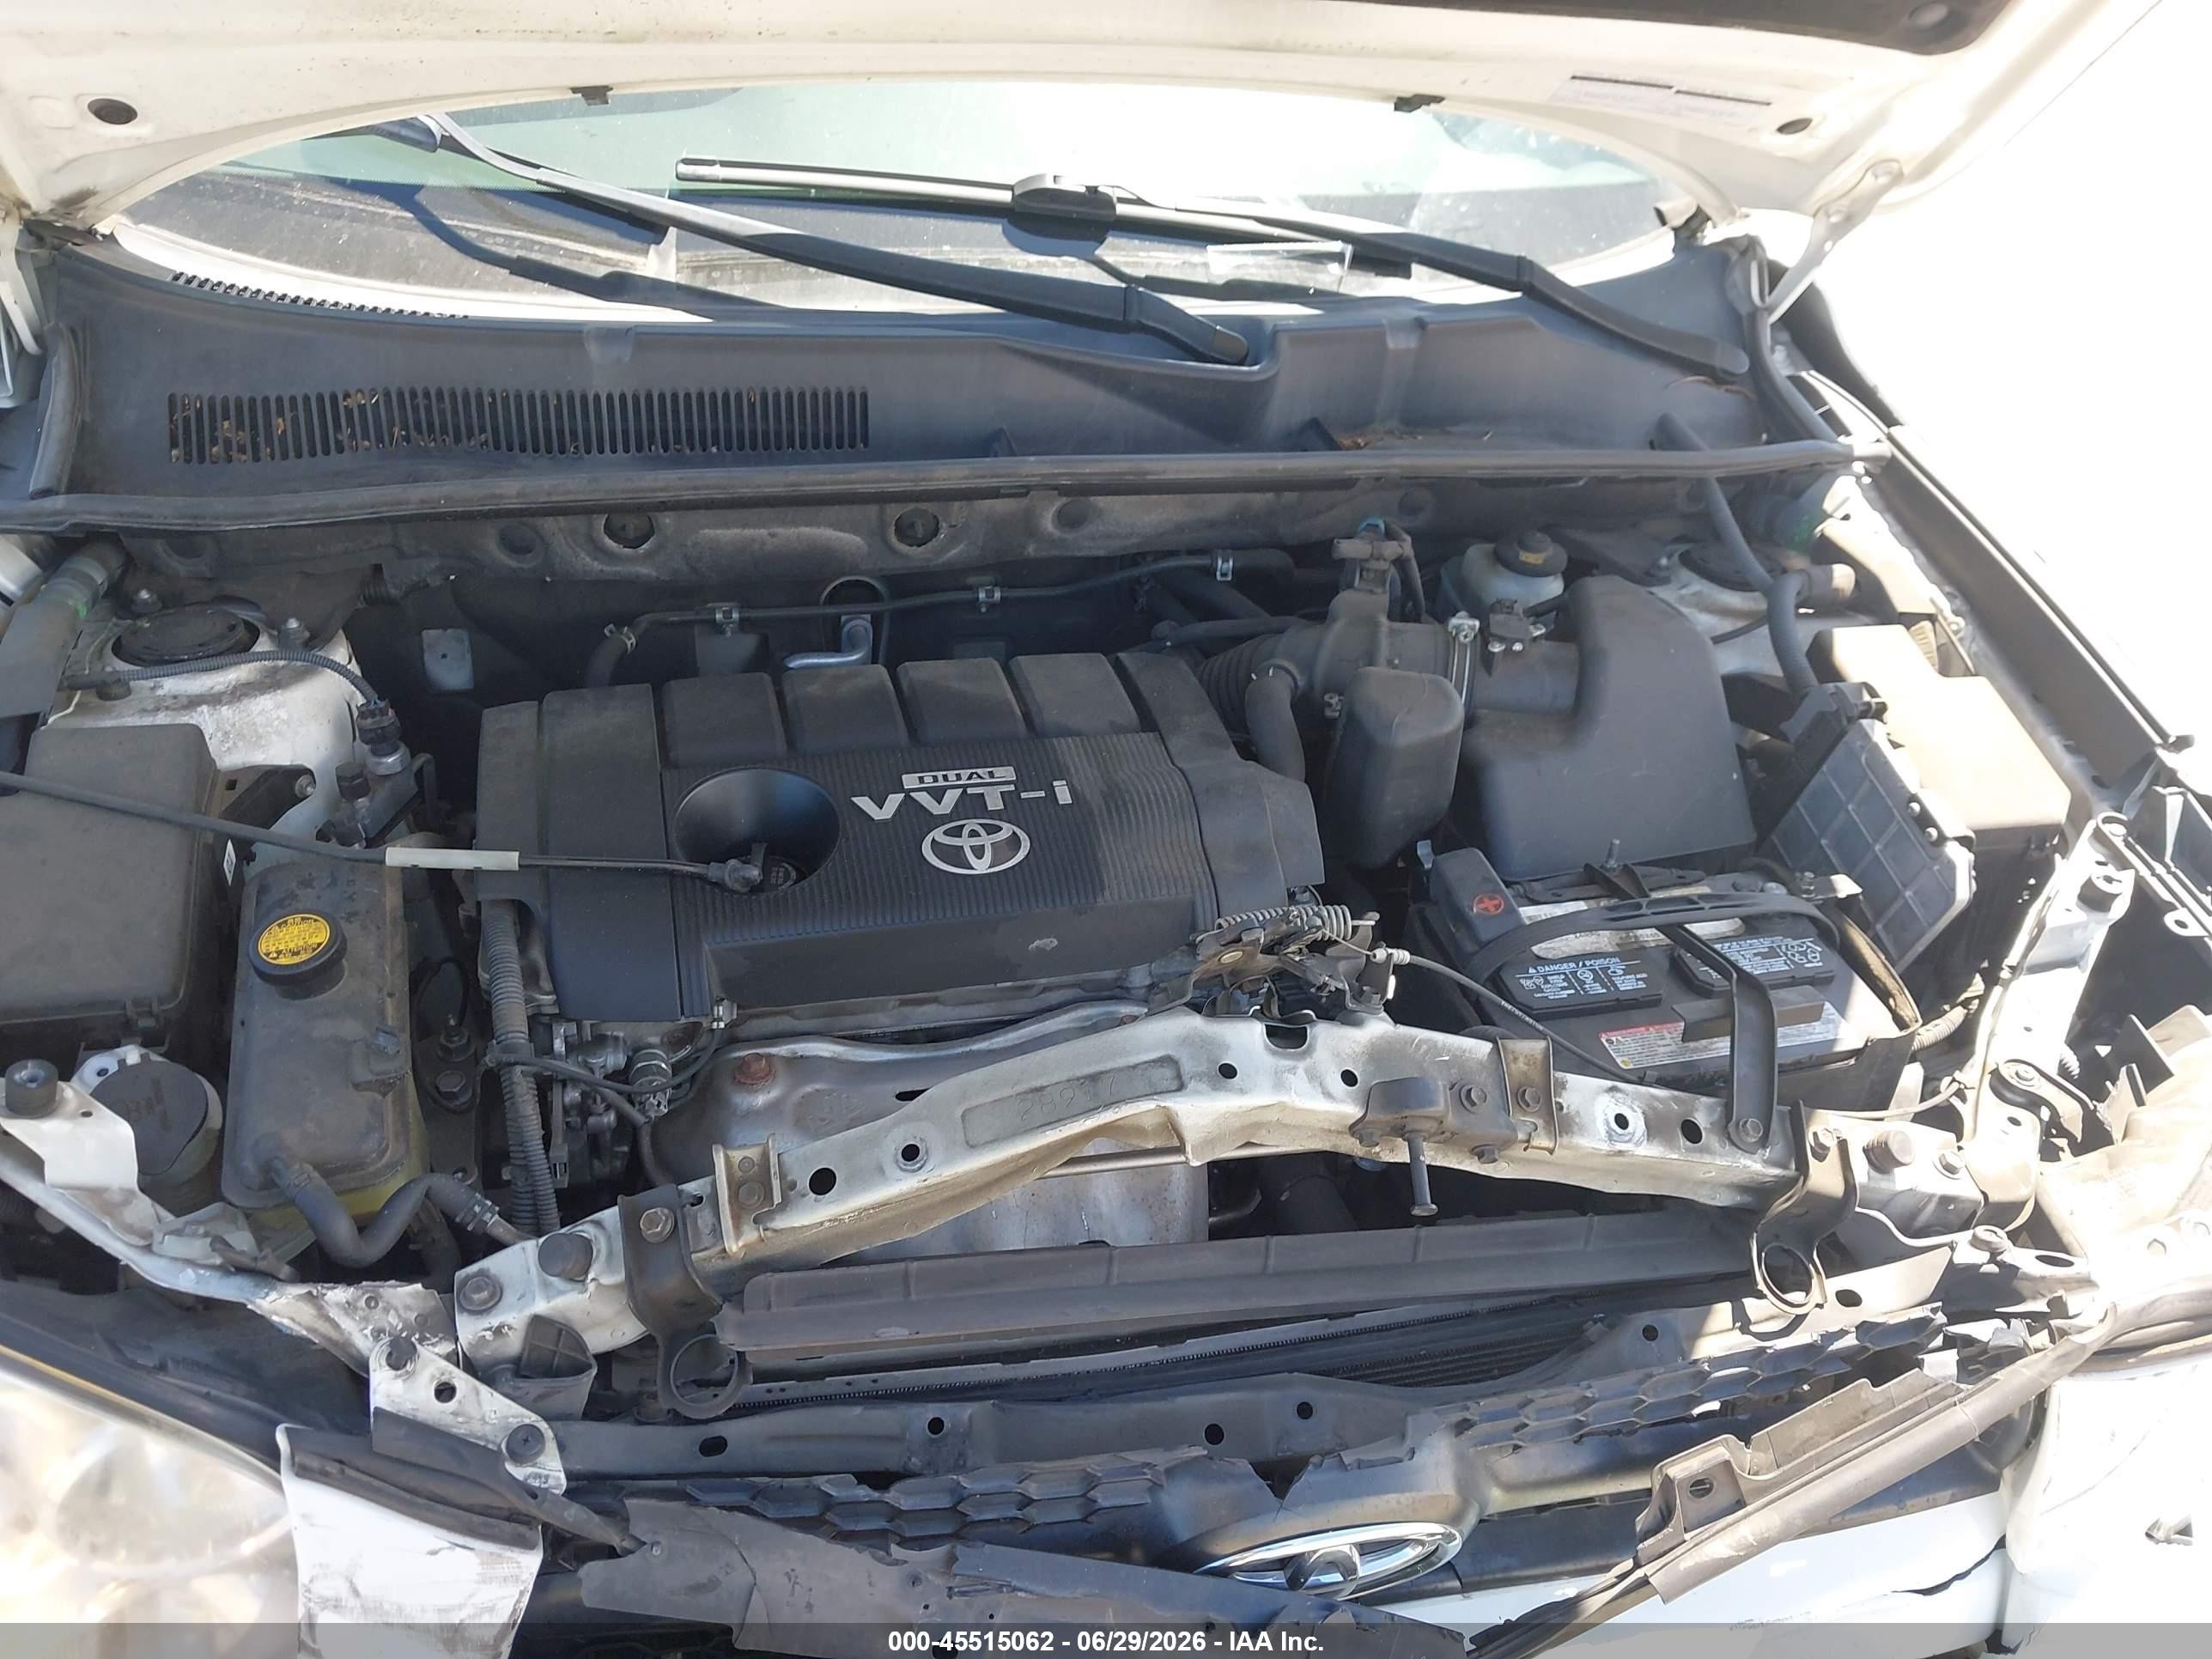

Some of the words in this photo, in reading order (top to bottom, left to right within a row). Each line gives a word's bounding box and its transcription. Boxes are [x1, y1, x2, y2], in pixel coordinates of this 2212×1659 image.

[917, 769, 1006, 783] DUAL
[851, 780, 1073, 820] VVT-i
[1536, 962, 1577, 973] DANGER
[1585, 957, 1621, 967] POISON
